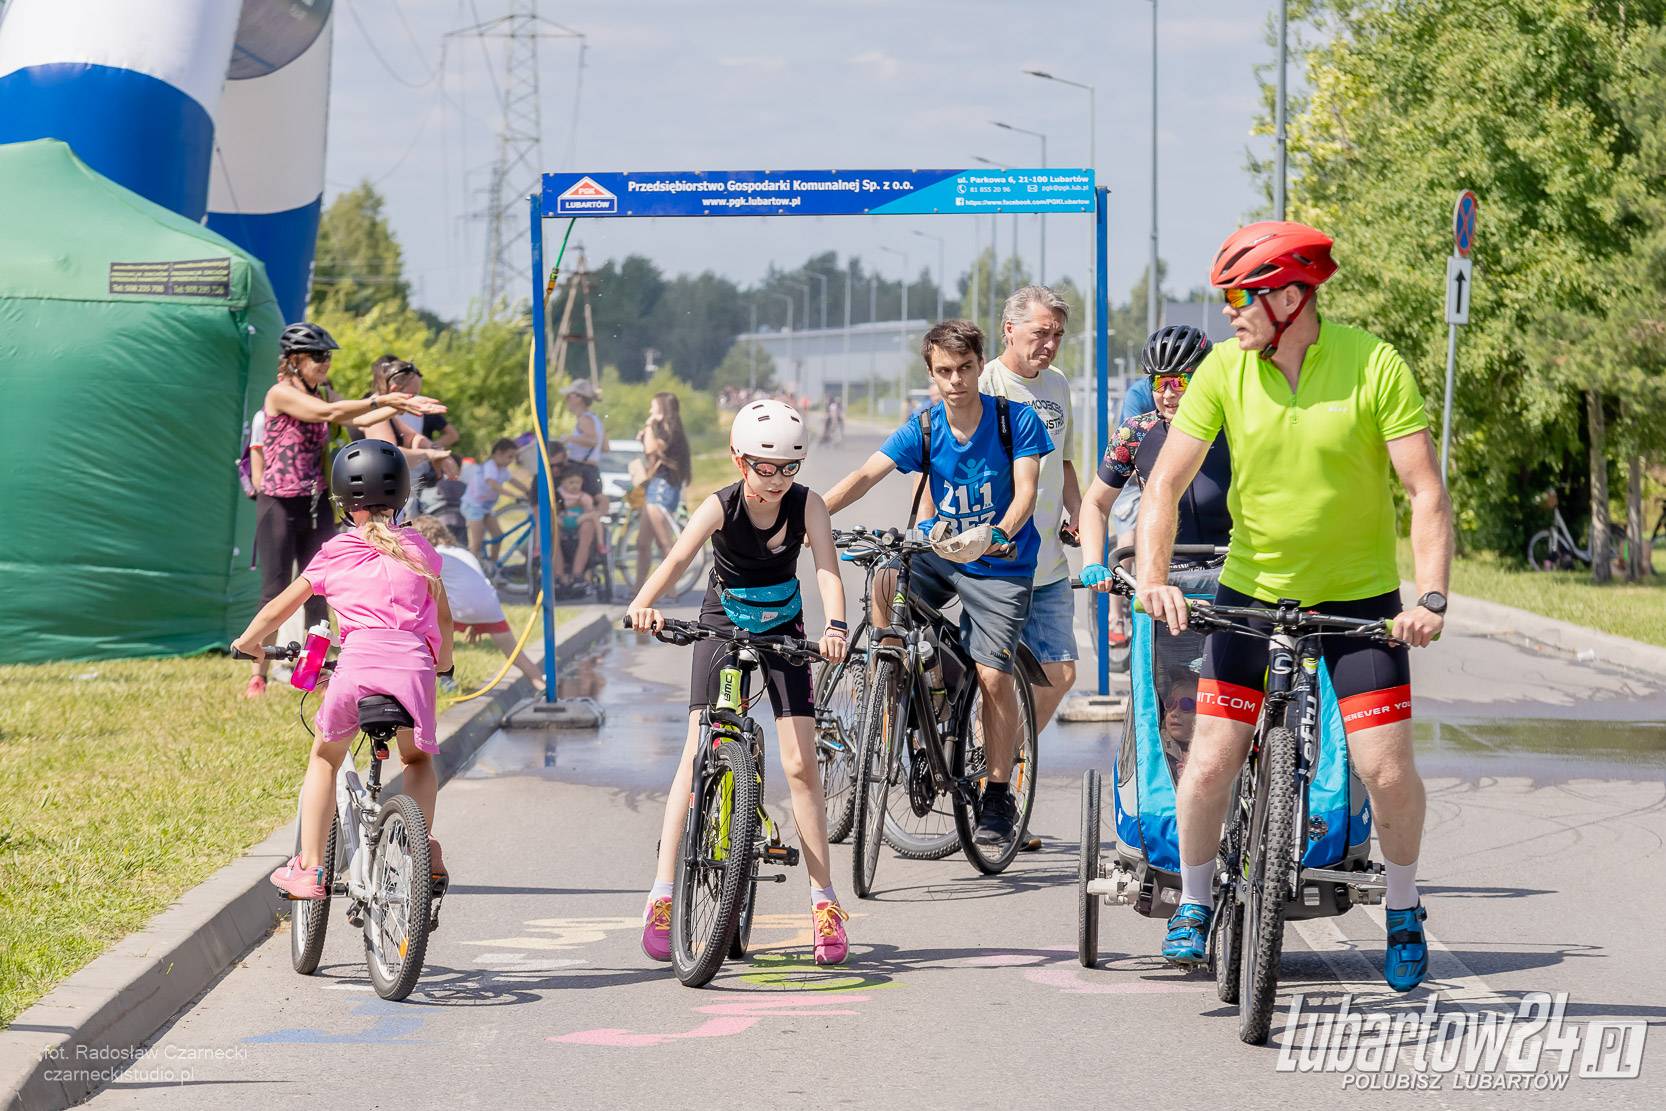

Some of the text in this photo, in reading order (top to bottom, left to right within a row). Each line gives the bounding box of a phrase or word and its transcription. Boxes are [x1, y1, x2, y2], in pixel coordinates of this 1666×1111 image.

[970, 176, 1006, 184] Parkowa
[1018, 175, 1048, 183] 21-100
[1049, 175, 1090, 183] Lubartów
[627, 179, 914, 194] Przedsiębiorstwo Gospodarki Komunalnej Sp. z o.o.
[565, 200, 611, 209] LUBARTÓW
[702, 196, 801, 208] www.pgk.lubartow.pl
[939, 479, 995, 515] 21.1
[723, 673, 733, 701] BMC
